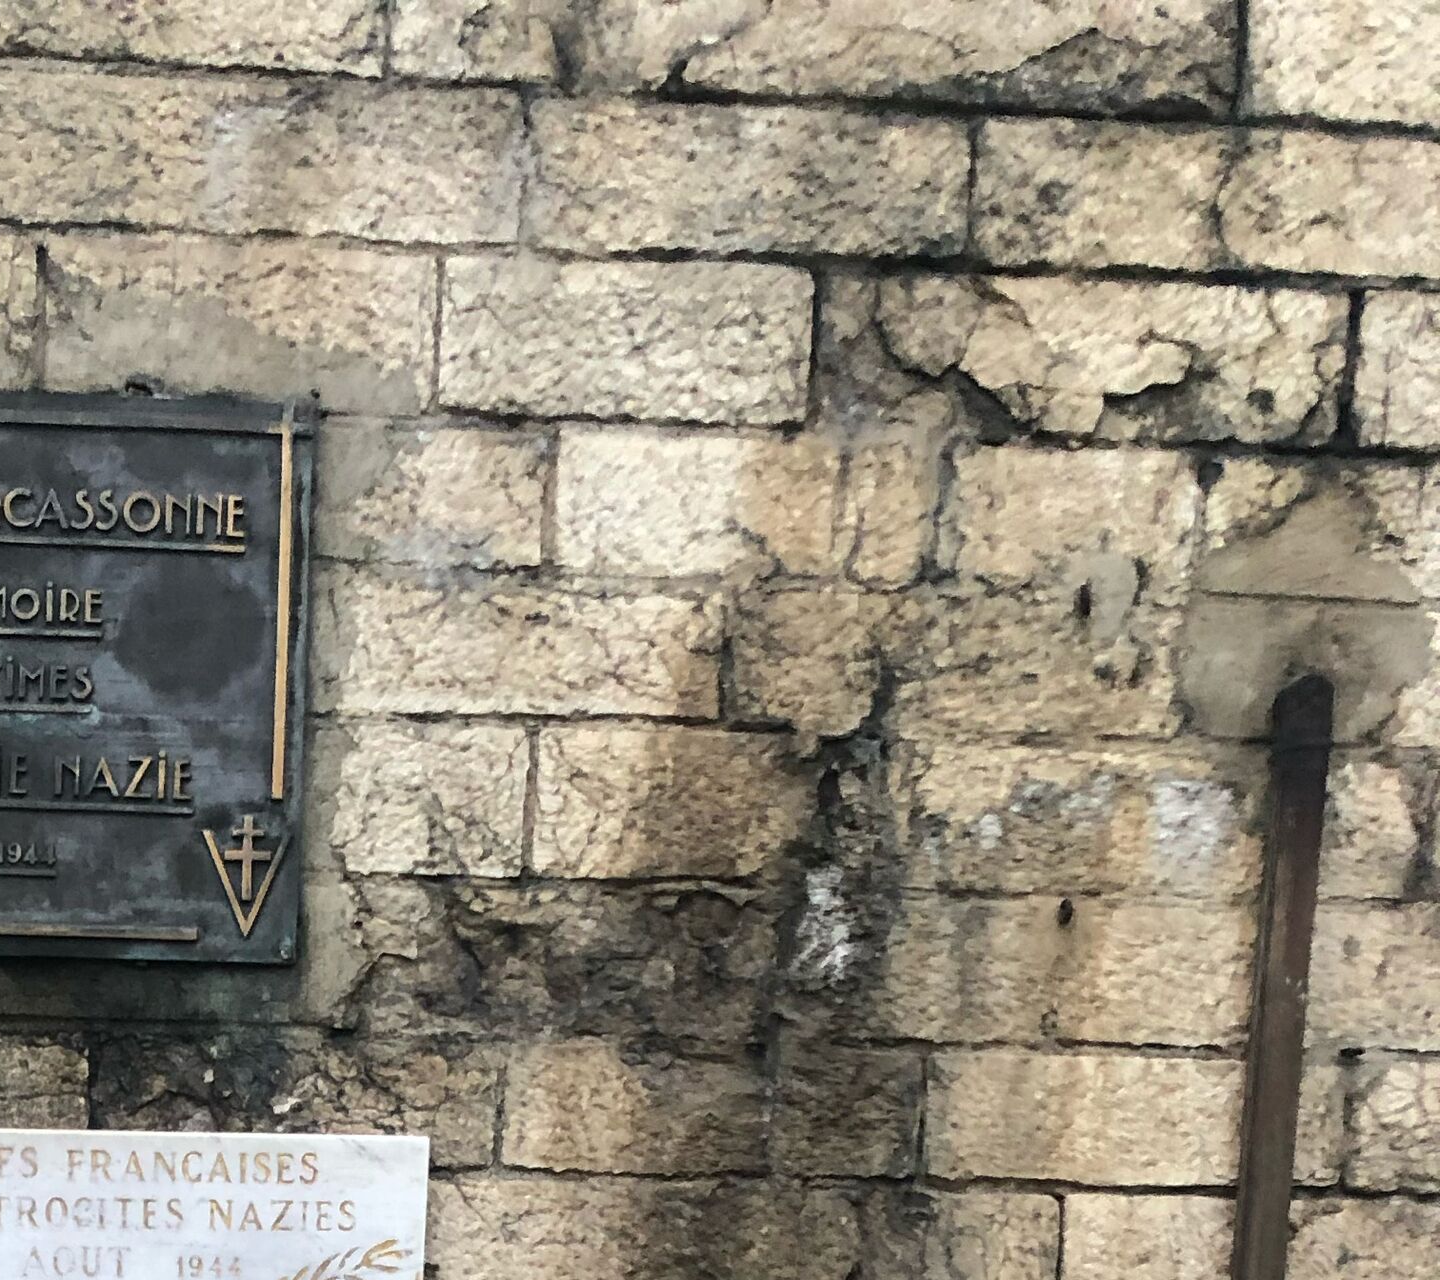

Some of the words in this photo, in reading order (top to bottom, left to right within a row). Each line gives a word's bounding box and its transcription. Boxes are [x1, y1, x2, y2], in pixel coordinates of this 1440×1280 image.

[54, 751, 193, 800] NAZIE
[66, 1148, 320, 1185] FRANCAISES
[208, 1198, 357, 1233] NAZIES
[22, 1245, 132, 1279] AOUT
[175, 1254, 242, 1278] 1944
